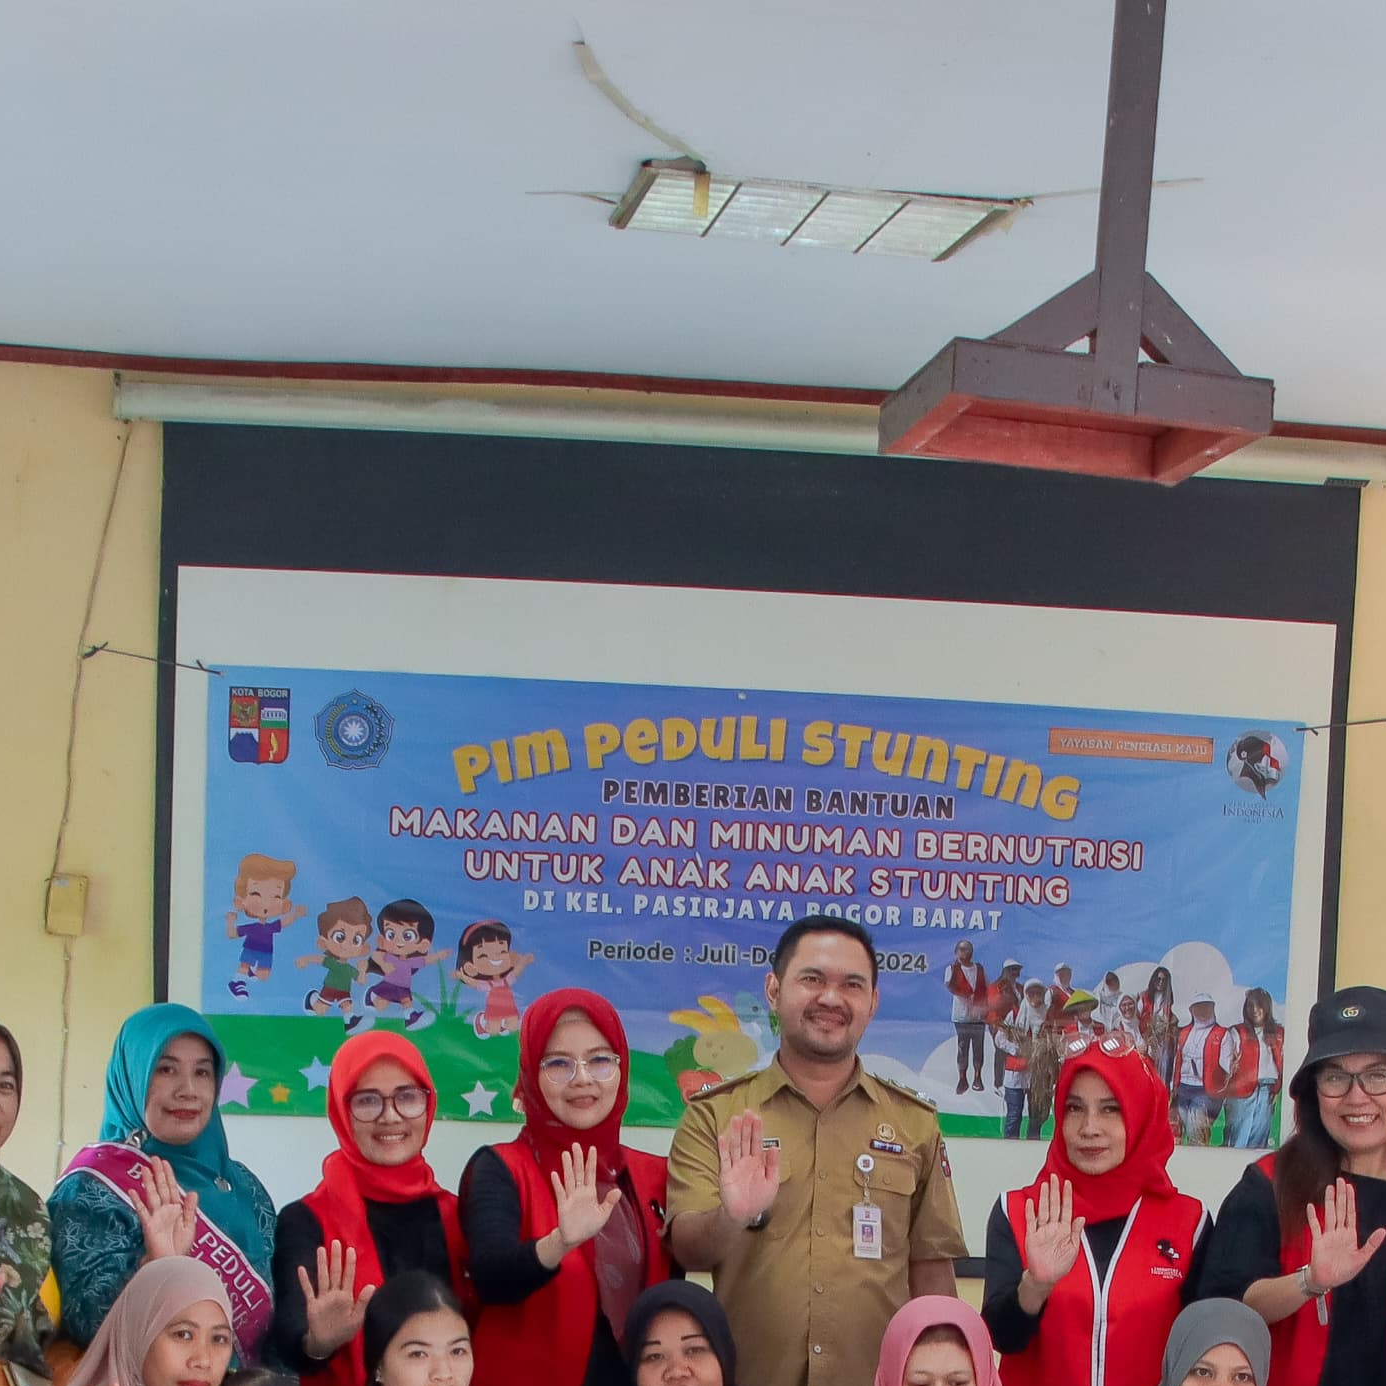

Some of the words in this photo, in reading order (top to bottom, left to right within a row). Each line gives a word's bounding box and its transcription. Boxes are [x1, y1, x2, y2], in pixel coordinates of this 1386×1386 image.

[231, 687, 255, 697] KOTA
[257, 688, 289, 698] BOGOR
[1060, 736, 1113, 750] YAYASAN
[1116, 740, 1172, 753] GENERASI
[1175, 743, 1208, 756] MAJU
[452, 728, 572, 794] PIM
[584, 715, 788, 770] PEDULI
[802, 720, 1081, 821] STUNTING
[601, 778, 794, 812] PEMBERIAN
[803, 787, 955, 820] BANTUAN
[389, 805, 598, 844] MAKANAN
[612, 815, 696, 849] DAN
[710, 819, 902, 858] MINUMAN
[915, 830, 1143, 871] BERNUTRISI
[464, 848, 605, 885] UNTUK
[616, 856, 731, 890] ANAK
[744, 861, 857, 896] ANAK
[869, 866, 1071, 906] STUNTING
[523, 889, 556, 912] DI
[565, 890, 624, 915] KEL.
[633, 894, 796, 922] PASIRJAYA
[912, 907, 1003, 931] BARAT
[587, 940, 675, 963] Periode
[875, 950, 928, 973] 2024
[198, 1230, 265, 1311] PEDULI
